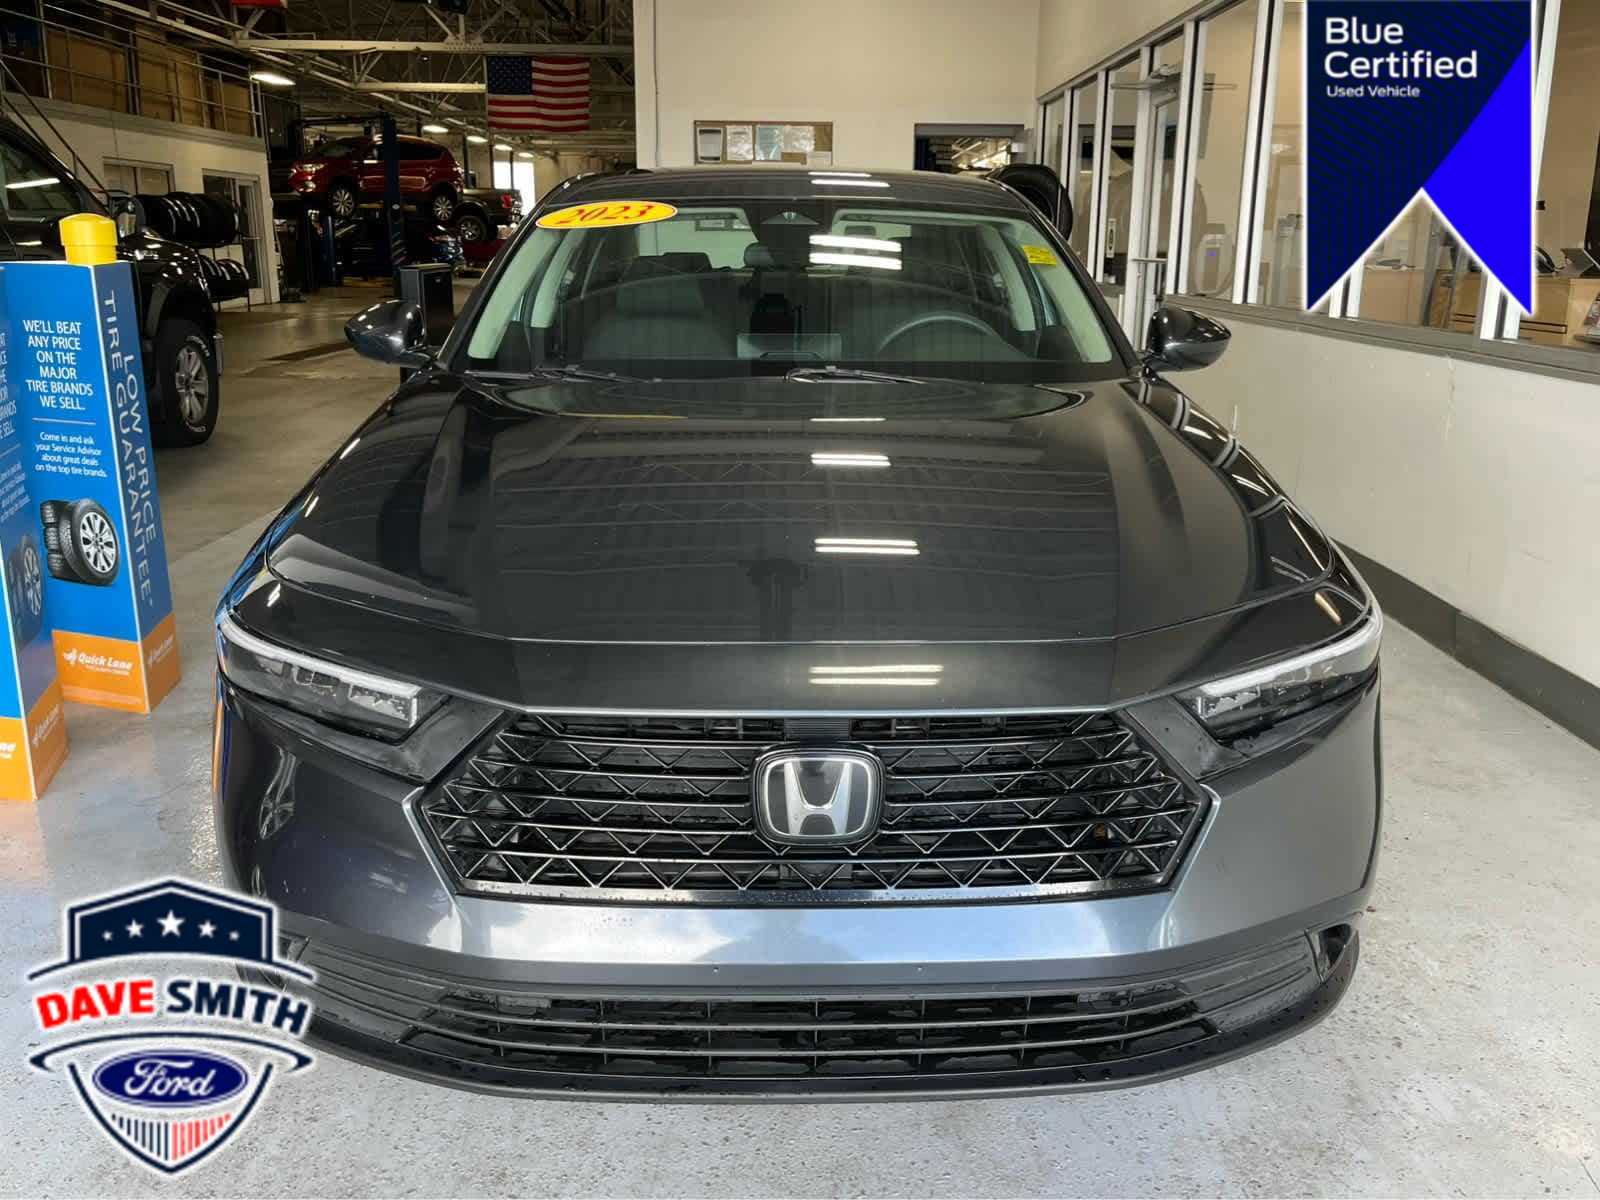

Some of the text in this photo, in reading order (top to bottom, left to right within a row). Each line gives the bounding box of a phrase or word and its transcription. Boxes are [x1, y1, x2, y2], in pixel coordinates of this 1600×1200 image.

[554, 204, 655, 226] 2023
[23, 320, 82, 335] WE'LL BEAT
[28, 335, 82, 350] ANY PRICE
[36, 350, 77, 365] ON THE
[40, 366, 77, 380] MAJOR
[25, 379, 94, 397] TIRE BRANDS
[40, 395, 86, 410] WE SELL.
[40, 432, 95, 445] Come in and ask
[104, 289, 151, 601] TIRE GUARANTEE
[35, 444, 51, 453] your
[52, 443, 76, 453] Service
[123, 354, 156, 544] LOW PRICE
[42, 453, 62, 462] about
[63, 455, 80, 465] great
[46, 464, 58, 472] the
[58, 465, 70, 475] top
[79, 652, 107, 667] Quick
[107, 657, 133, 670] Lane
